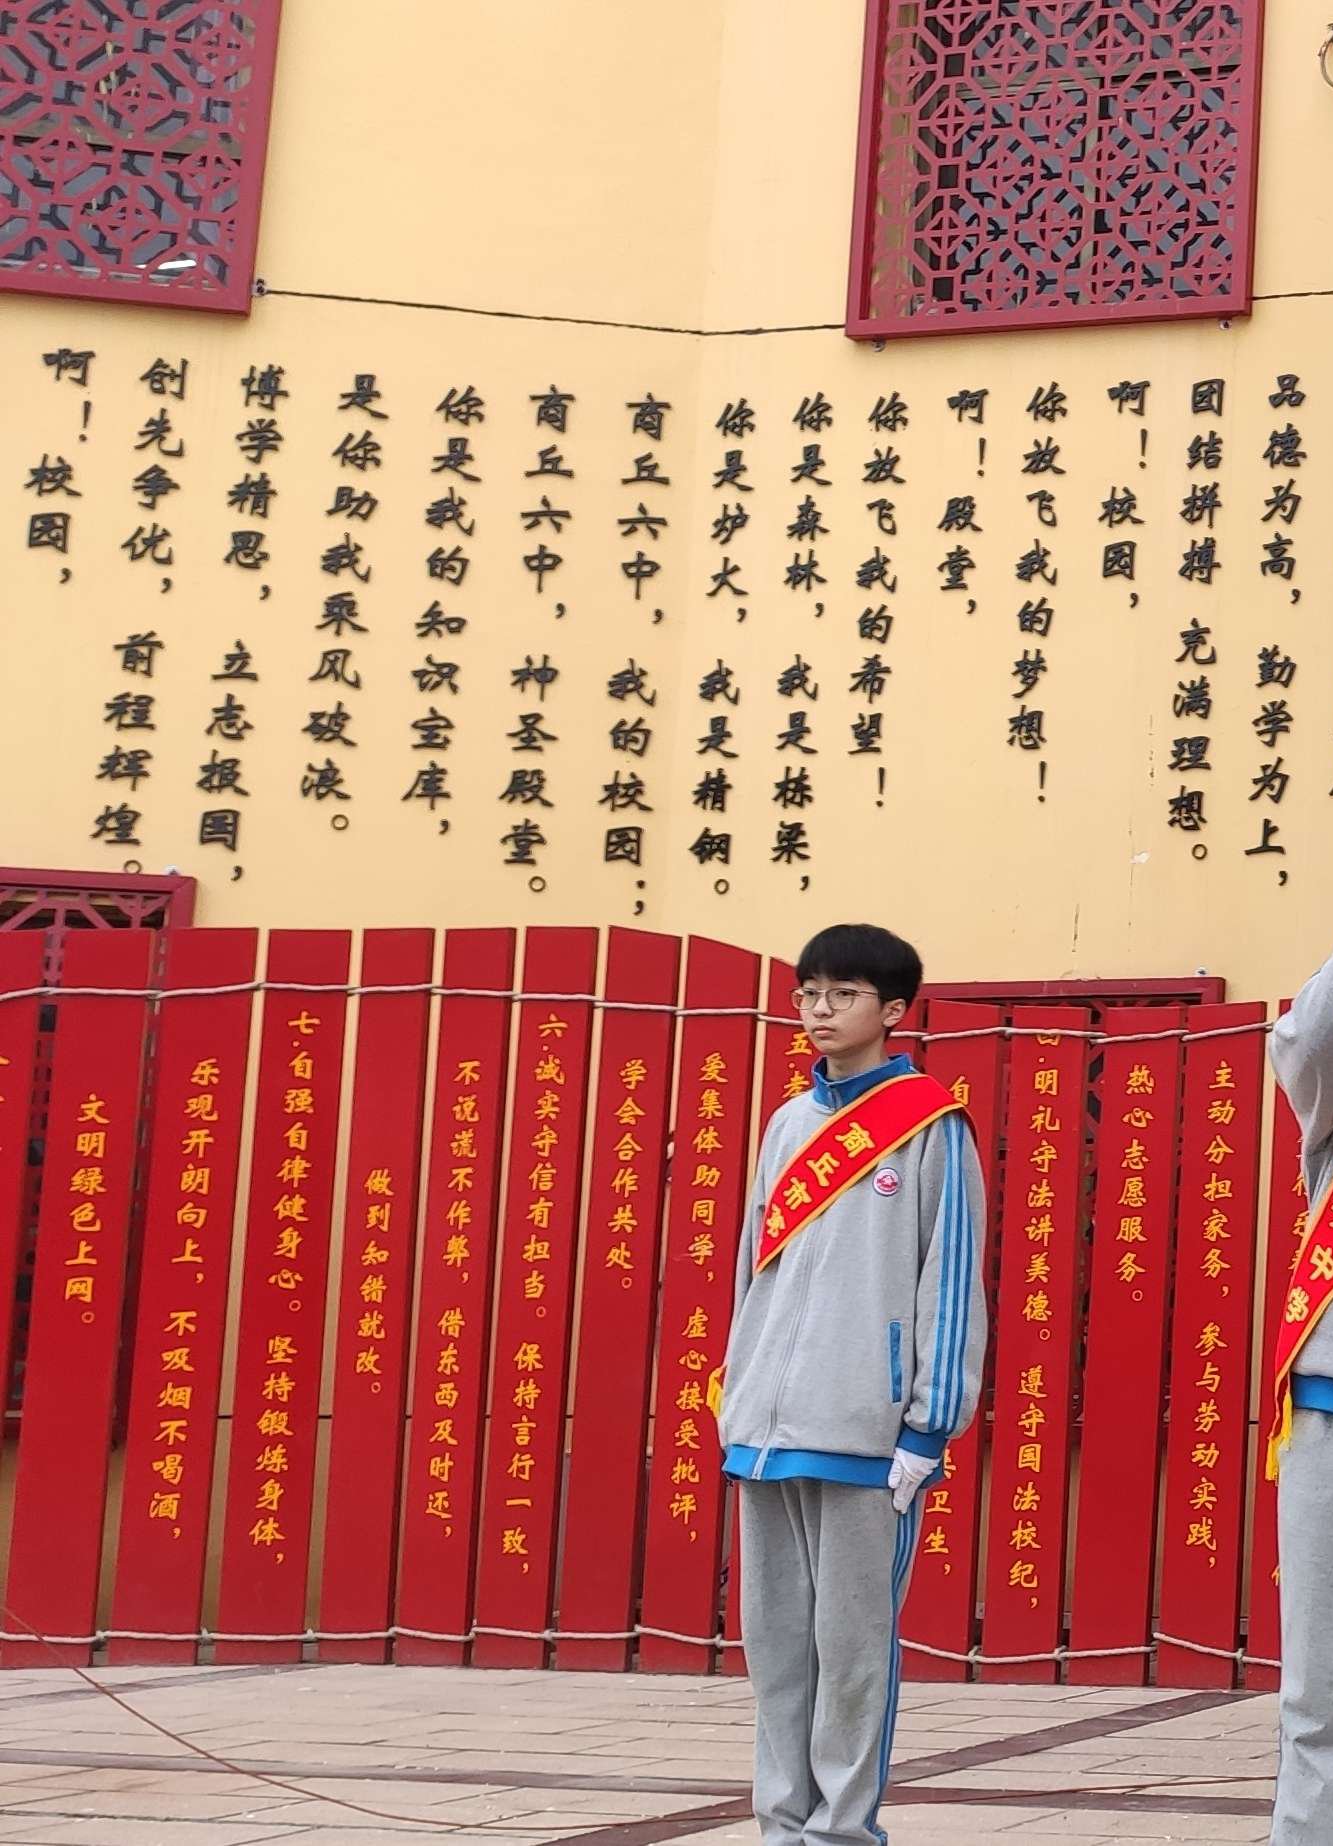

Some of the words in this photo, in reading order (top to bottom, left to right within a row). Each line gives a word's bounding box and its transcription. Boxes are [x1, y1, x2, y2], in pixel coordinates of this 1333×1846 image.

[848, 392, 909, 807] 你放飞我的希望！
[1006, 381, 1068, 801] 你放飞我的梦想！
[65, 1094, 110, 1324] 文明绿色上网。
[356, 1168, 394, 1395] 做到知错就改。
[606, 1059, 647, 1290] 学会合作共处。
